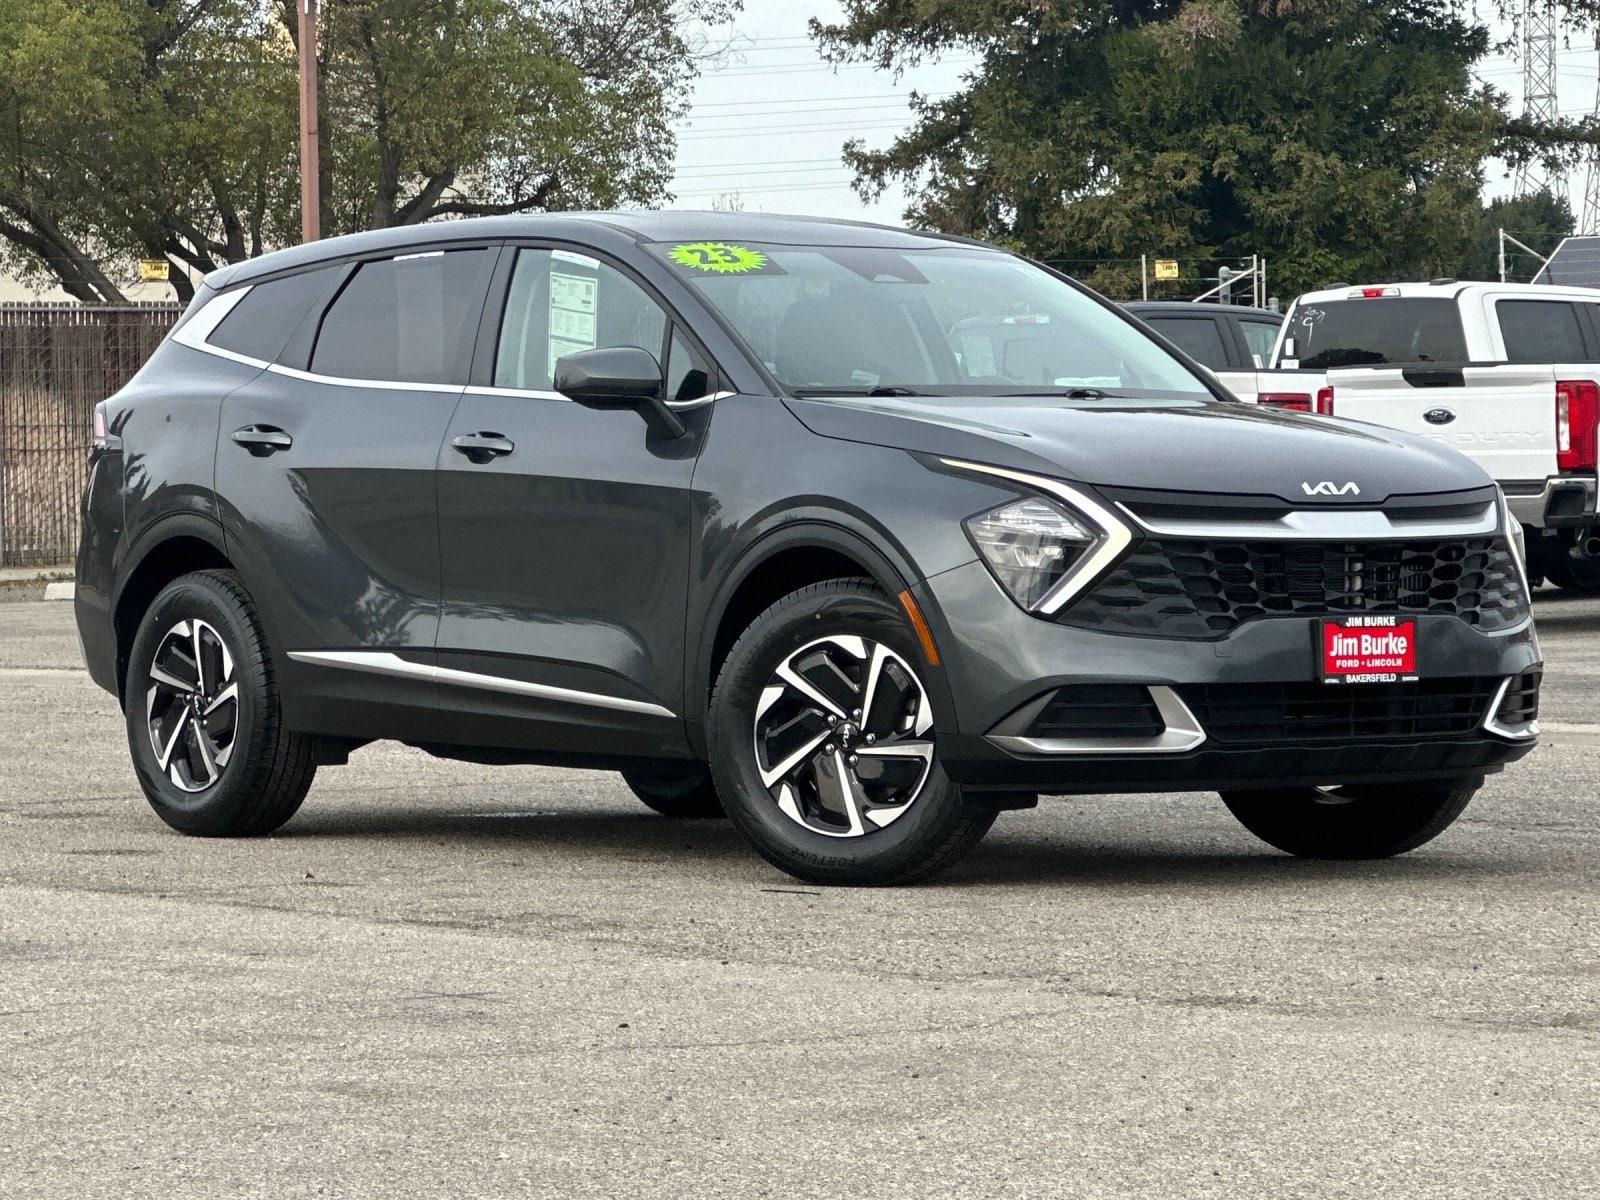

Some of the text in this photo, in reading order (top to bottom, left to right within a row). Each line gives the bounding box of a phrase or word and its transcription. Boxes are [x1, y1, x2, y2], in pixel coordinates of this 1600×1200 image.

[686, 247, 741, 264] 23
[1301, 481, 1360, 496] KIA
[1345, 616, 1396, 627] JIM BURKE
[1330, 631, 1408, 657] Jim Burke
[1336, 658, 1403, 668] FORD LINCOLN
[1346, 673, 1397, 683] BAKERSFIELD
